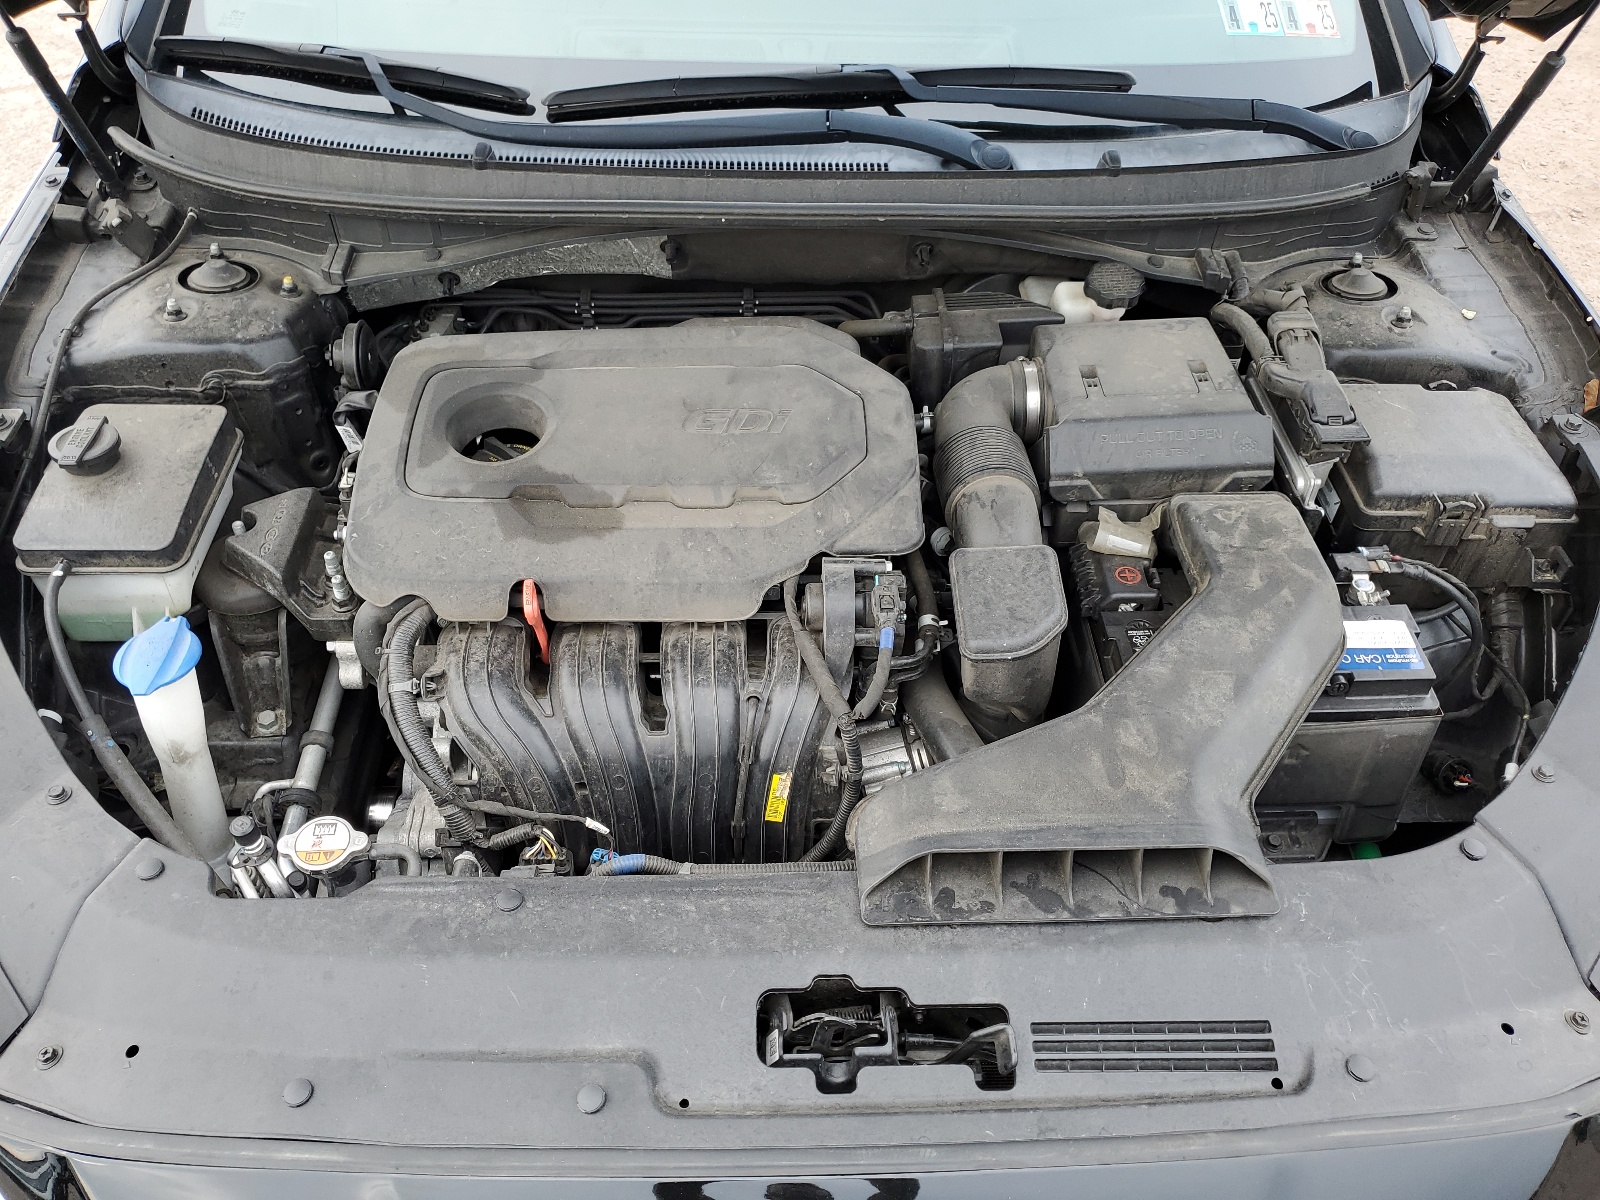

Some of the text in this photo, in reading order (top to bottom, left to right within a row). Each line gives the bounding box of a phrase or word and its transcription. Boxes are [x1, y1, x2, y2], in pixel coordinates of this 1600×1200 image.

[1228, 5, 1241, 29] 4
[1260, 2, 1278, 28] 25
[1287, 6, 1299, 30] 4
[1101, 428, 1223, 445] PULL OUT TO OPEN
[1353, 654, 1382, 664] CAR
